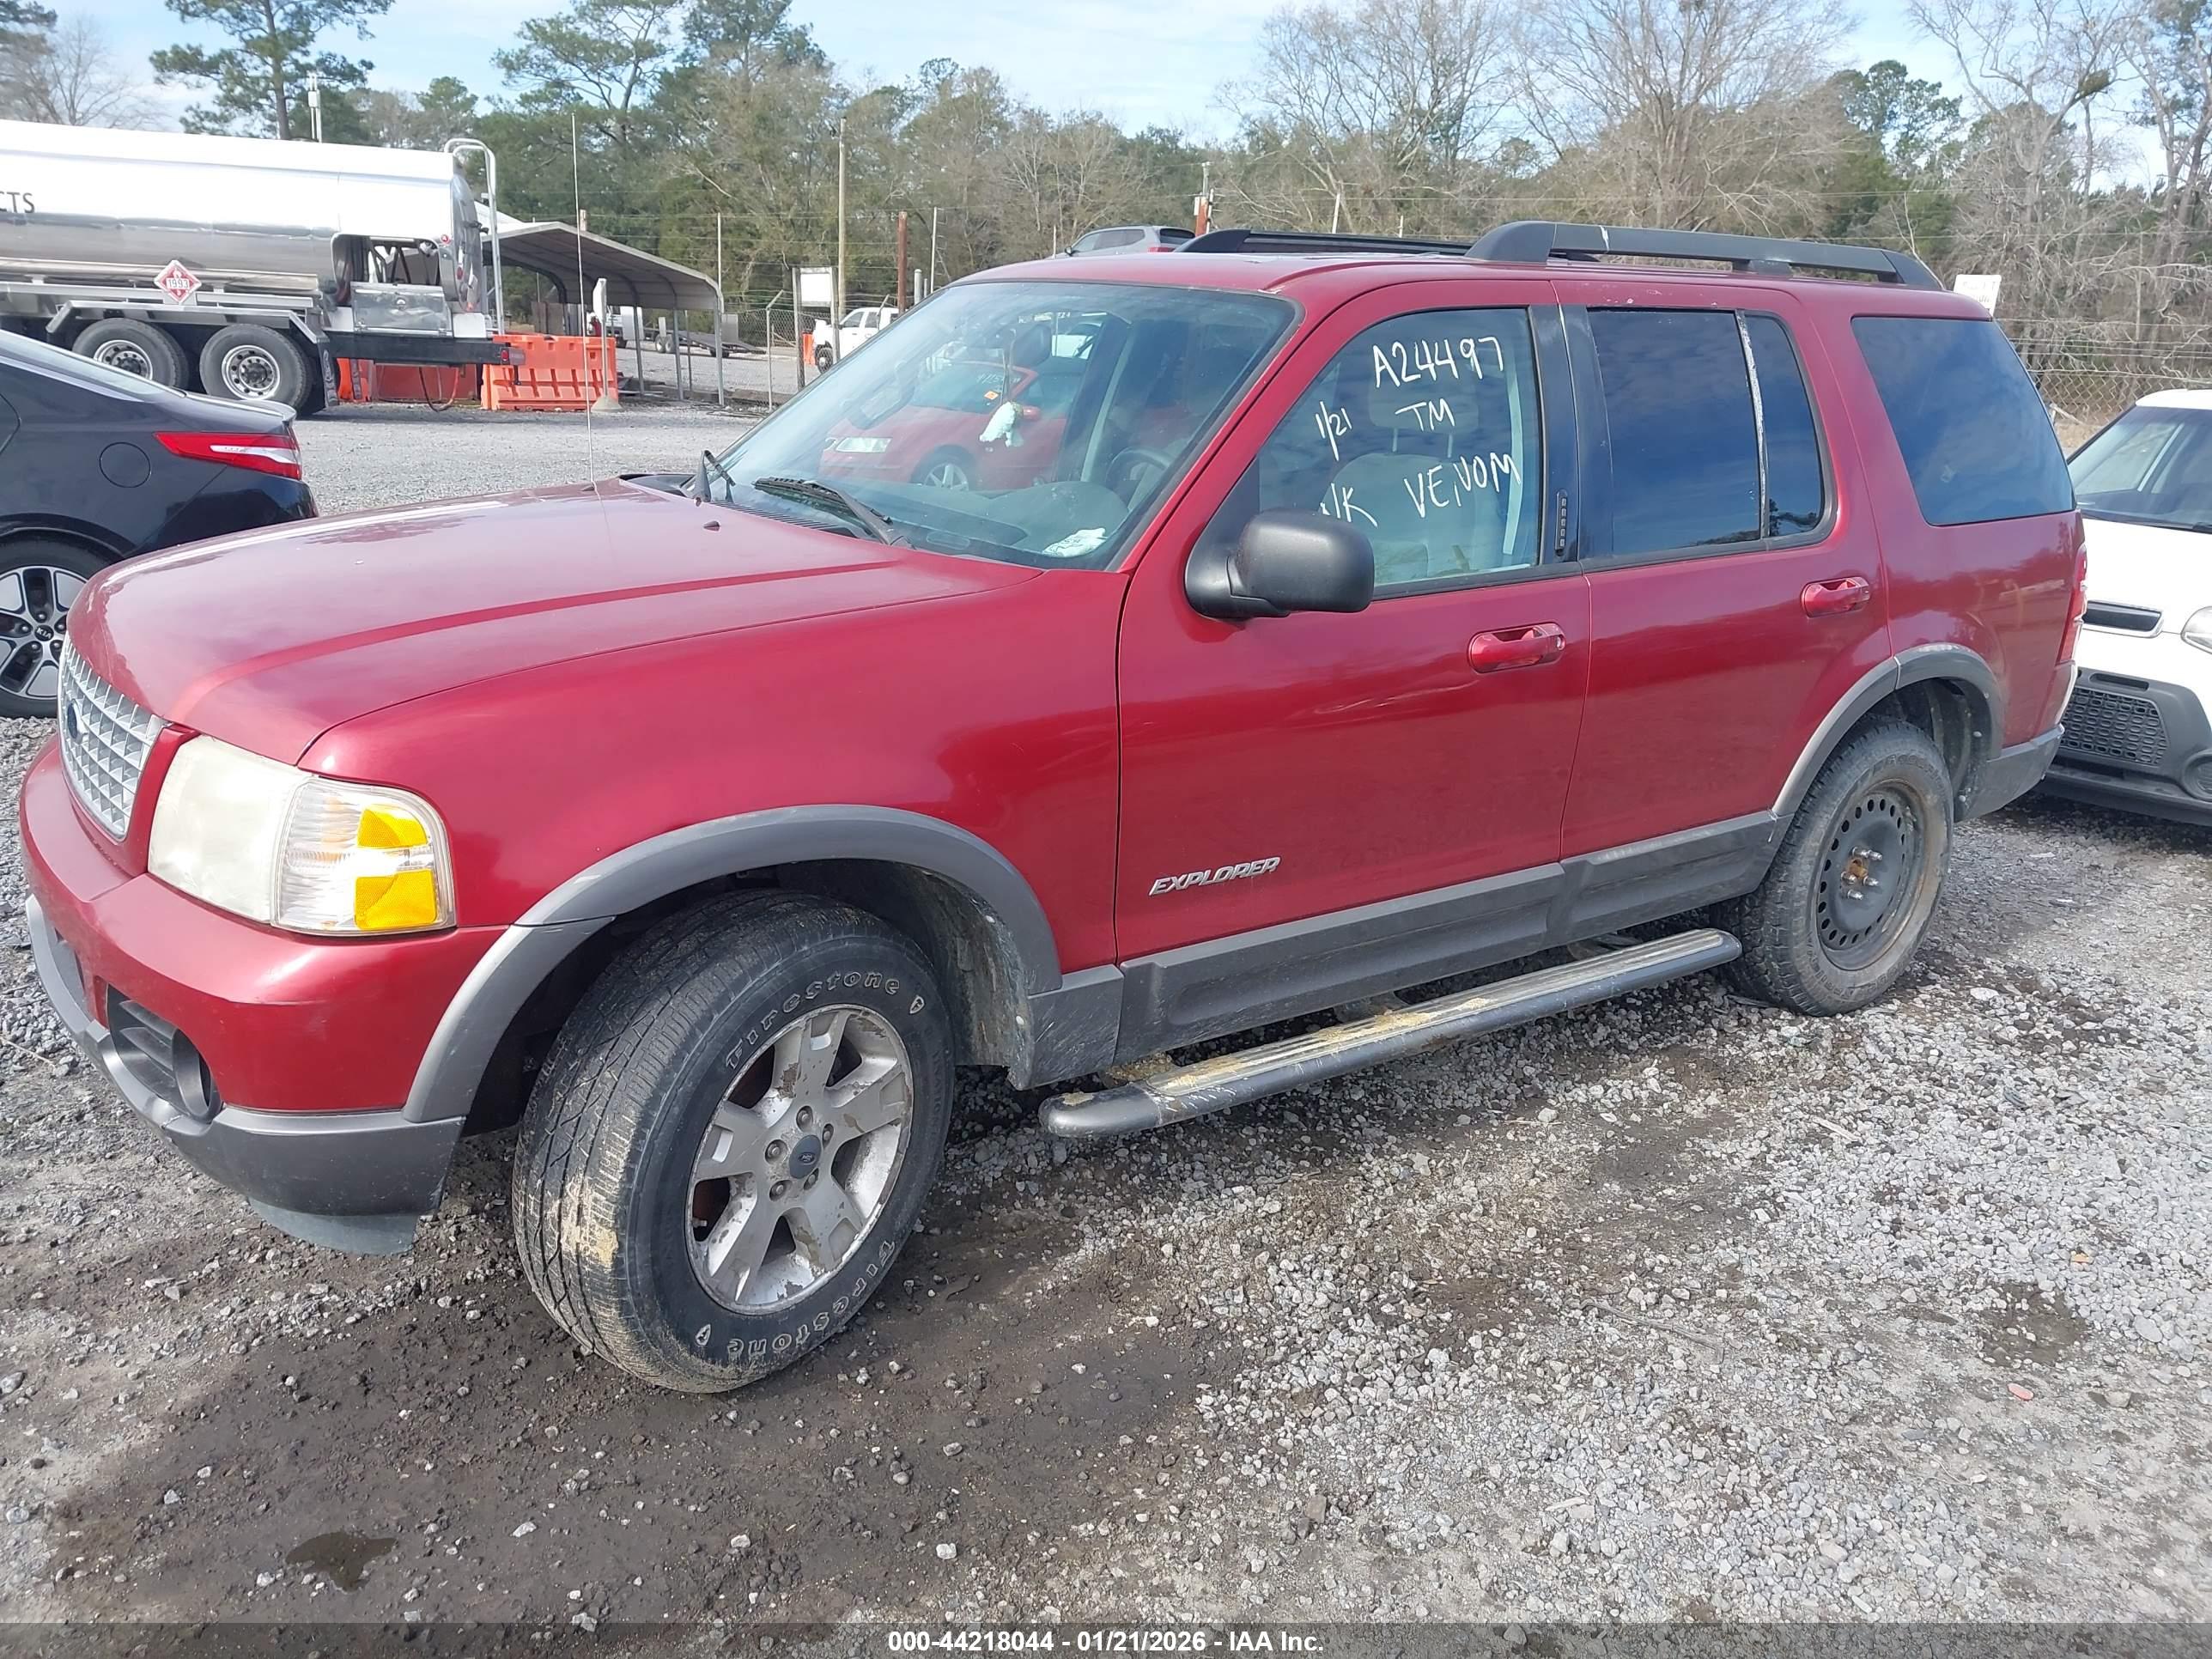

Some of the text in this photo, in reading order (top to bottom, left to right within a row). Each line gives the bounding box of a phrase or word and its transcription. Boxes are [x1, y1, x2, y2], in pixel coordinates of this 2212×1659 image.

[168, 278, 189, 289] 1993
[1372, 337, 1504, 388] A24497
[1315, 400, 1352, 461] 1/21
[1395, 398, 1455, 431] TM
[1319, 482, 1378, 528] /K
[1403, 452, 1522, 518] VENOM
[1148, 856, 1282, 897] EXPLORER
